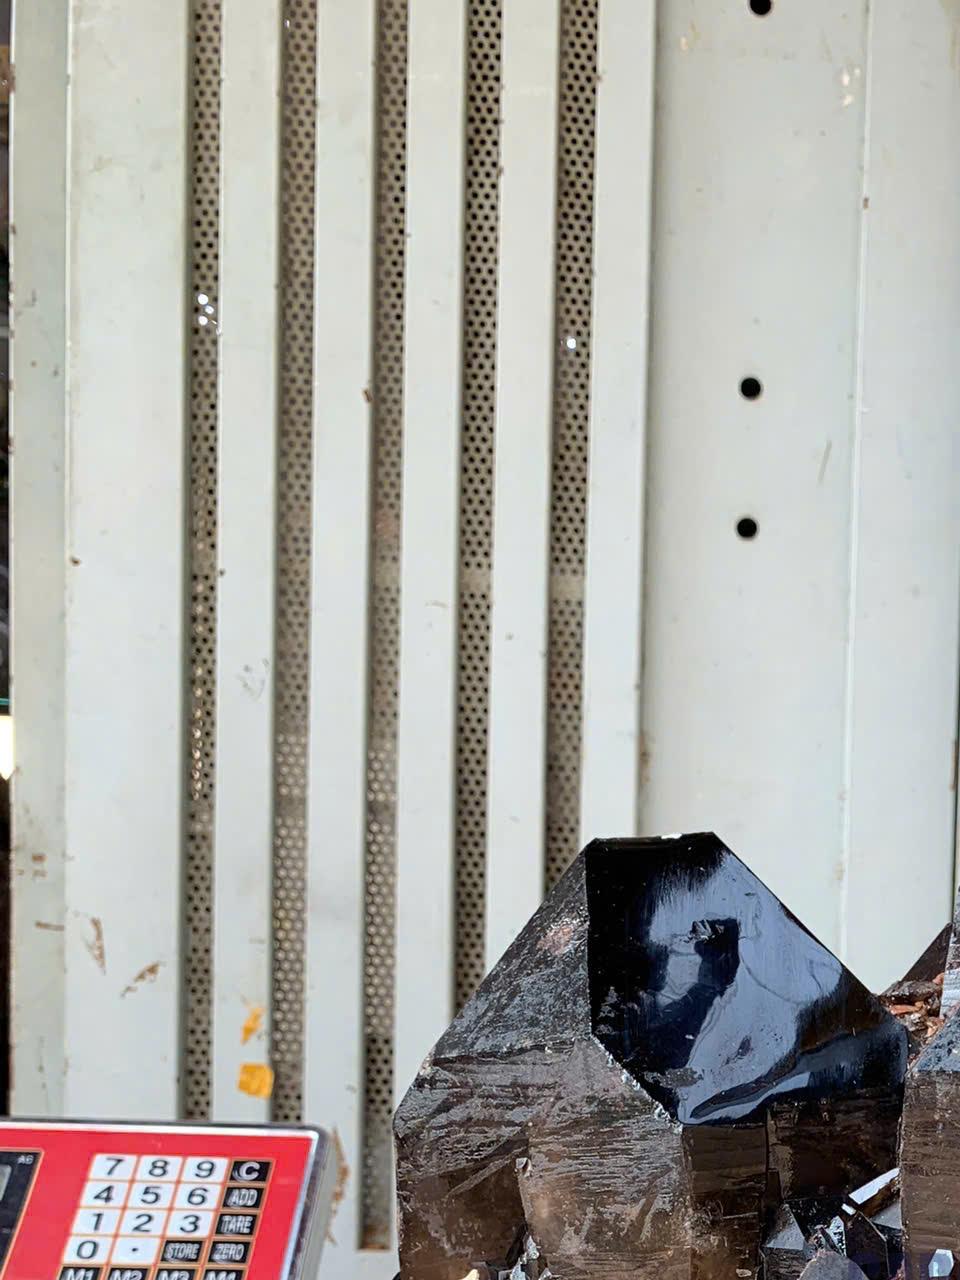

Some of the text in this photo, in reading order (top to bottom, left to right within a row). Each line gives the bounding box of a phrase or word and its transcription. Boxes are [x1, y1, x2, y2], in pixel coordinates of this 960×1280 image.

[105, 1158, 260, 1179] 7 8 9 C
[94, 1186, 257, 1206] 4 5 6 ADD
[93, 1213, 251, 1234] 1 2 3 TARE
[76, 1241, 98, 1259] 0
[166, 1242, 200, 1261] STORE
[212, 1243, 245, 1261] ZERO
